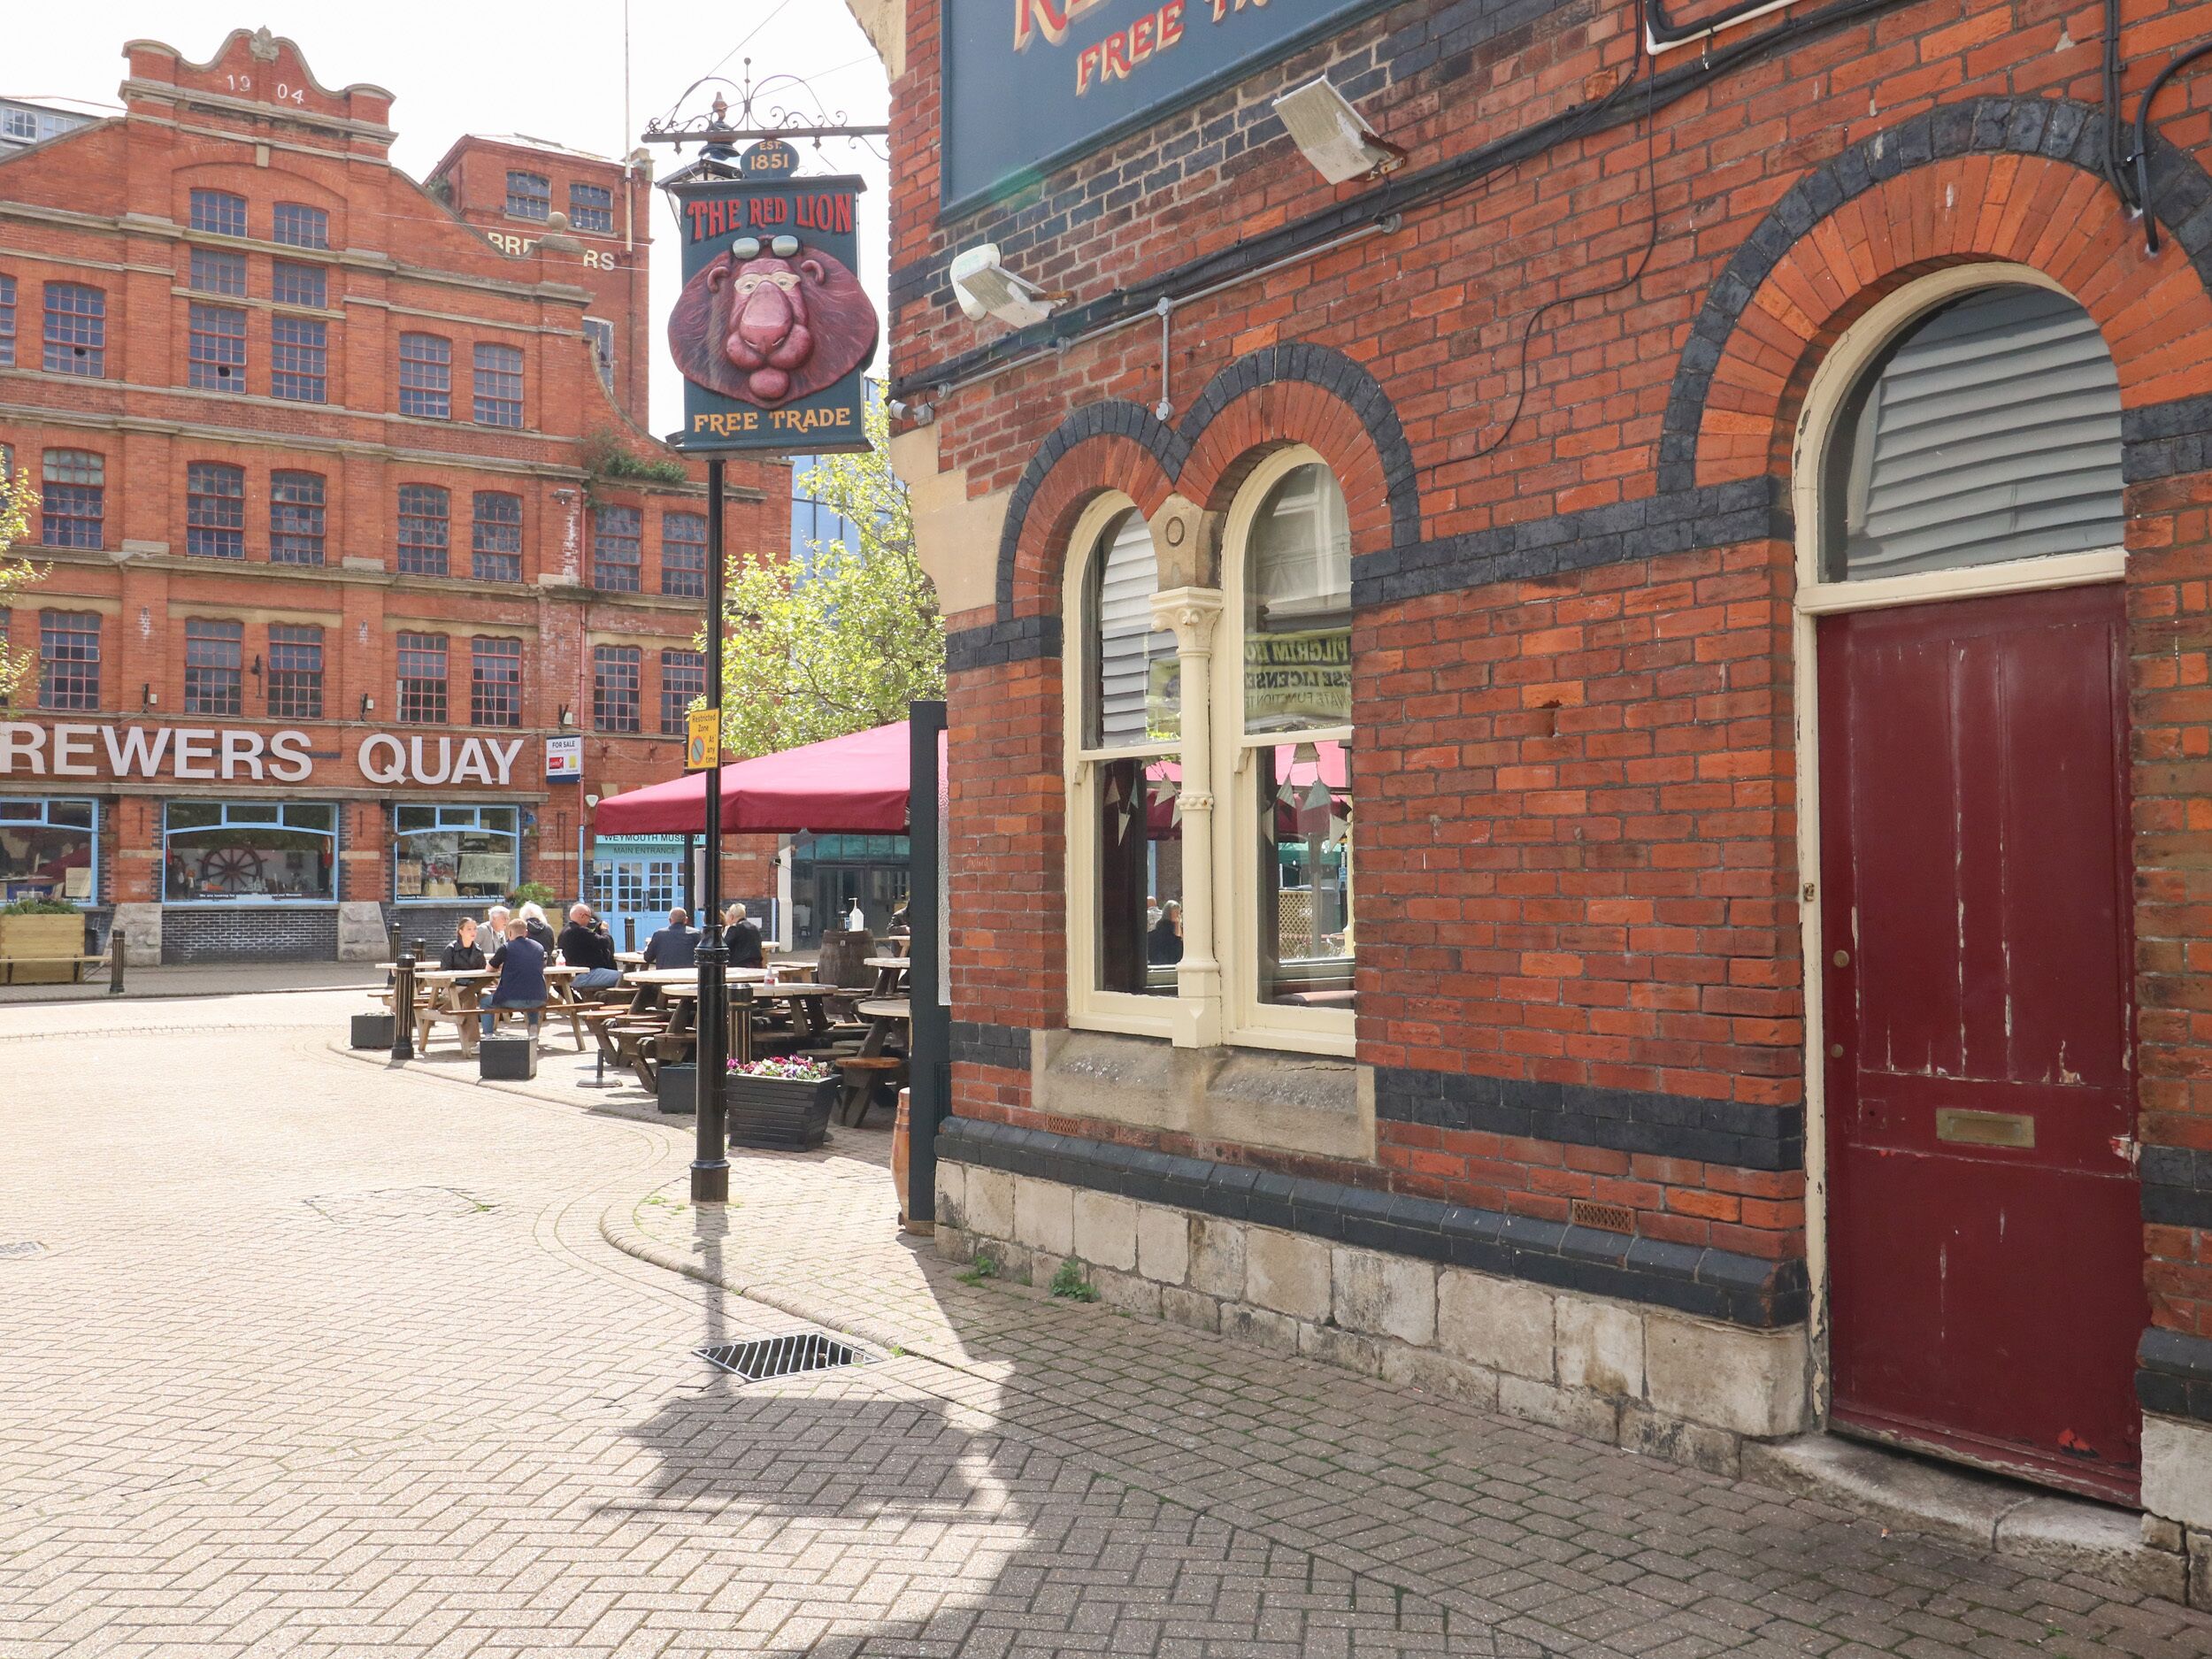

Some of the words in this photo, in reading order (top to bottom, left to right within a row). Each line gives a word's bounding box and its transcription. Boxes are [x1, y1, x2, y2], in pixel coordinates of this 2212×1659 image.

[1075, 0, 1186, 96] FREE
[759, 140, 782, 150] EST.
[750, 154, 789, 170] 1851
[687, 197, 741, 241] THE
[749, 196, 787, 229] RED
[796, 193, 852, 234] LION
[693, 411, 759, 437] FREE
[769, 407, 851, 434] TRADE
[693, 713, 716, 723] Restricted
[698, 724, 709, 733] Zone
[358, 733, 524, 785] QUAY
